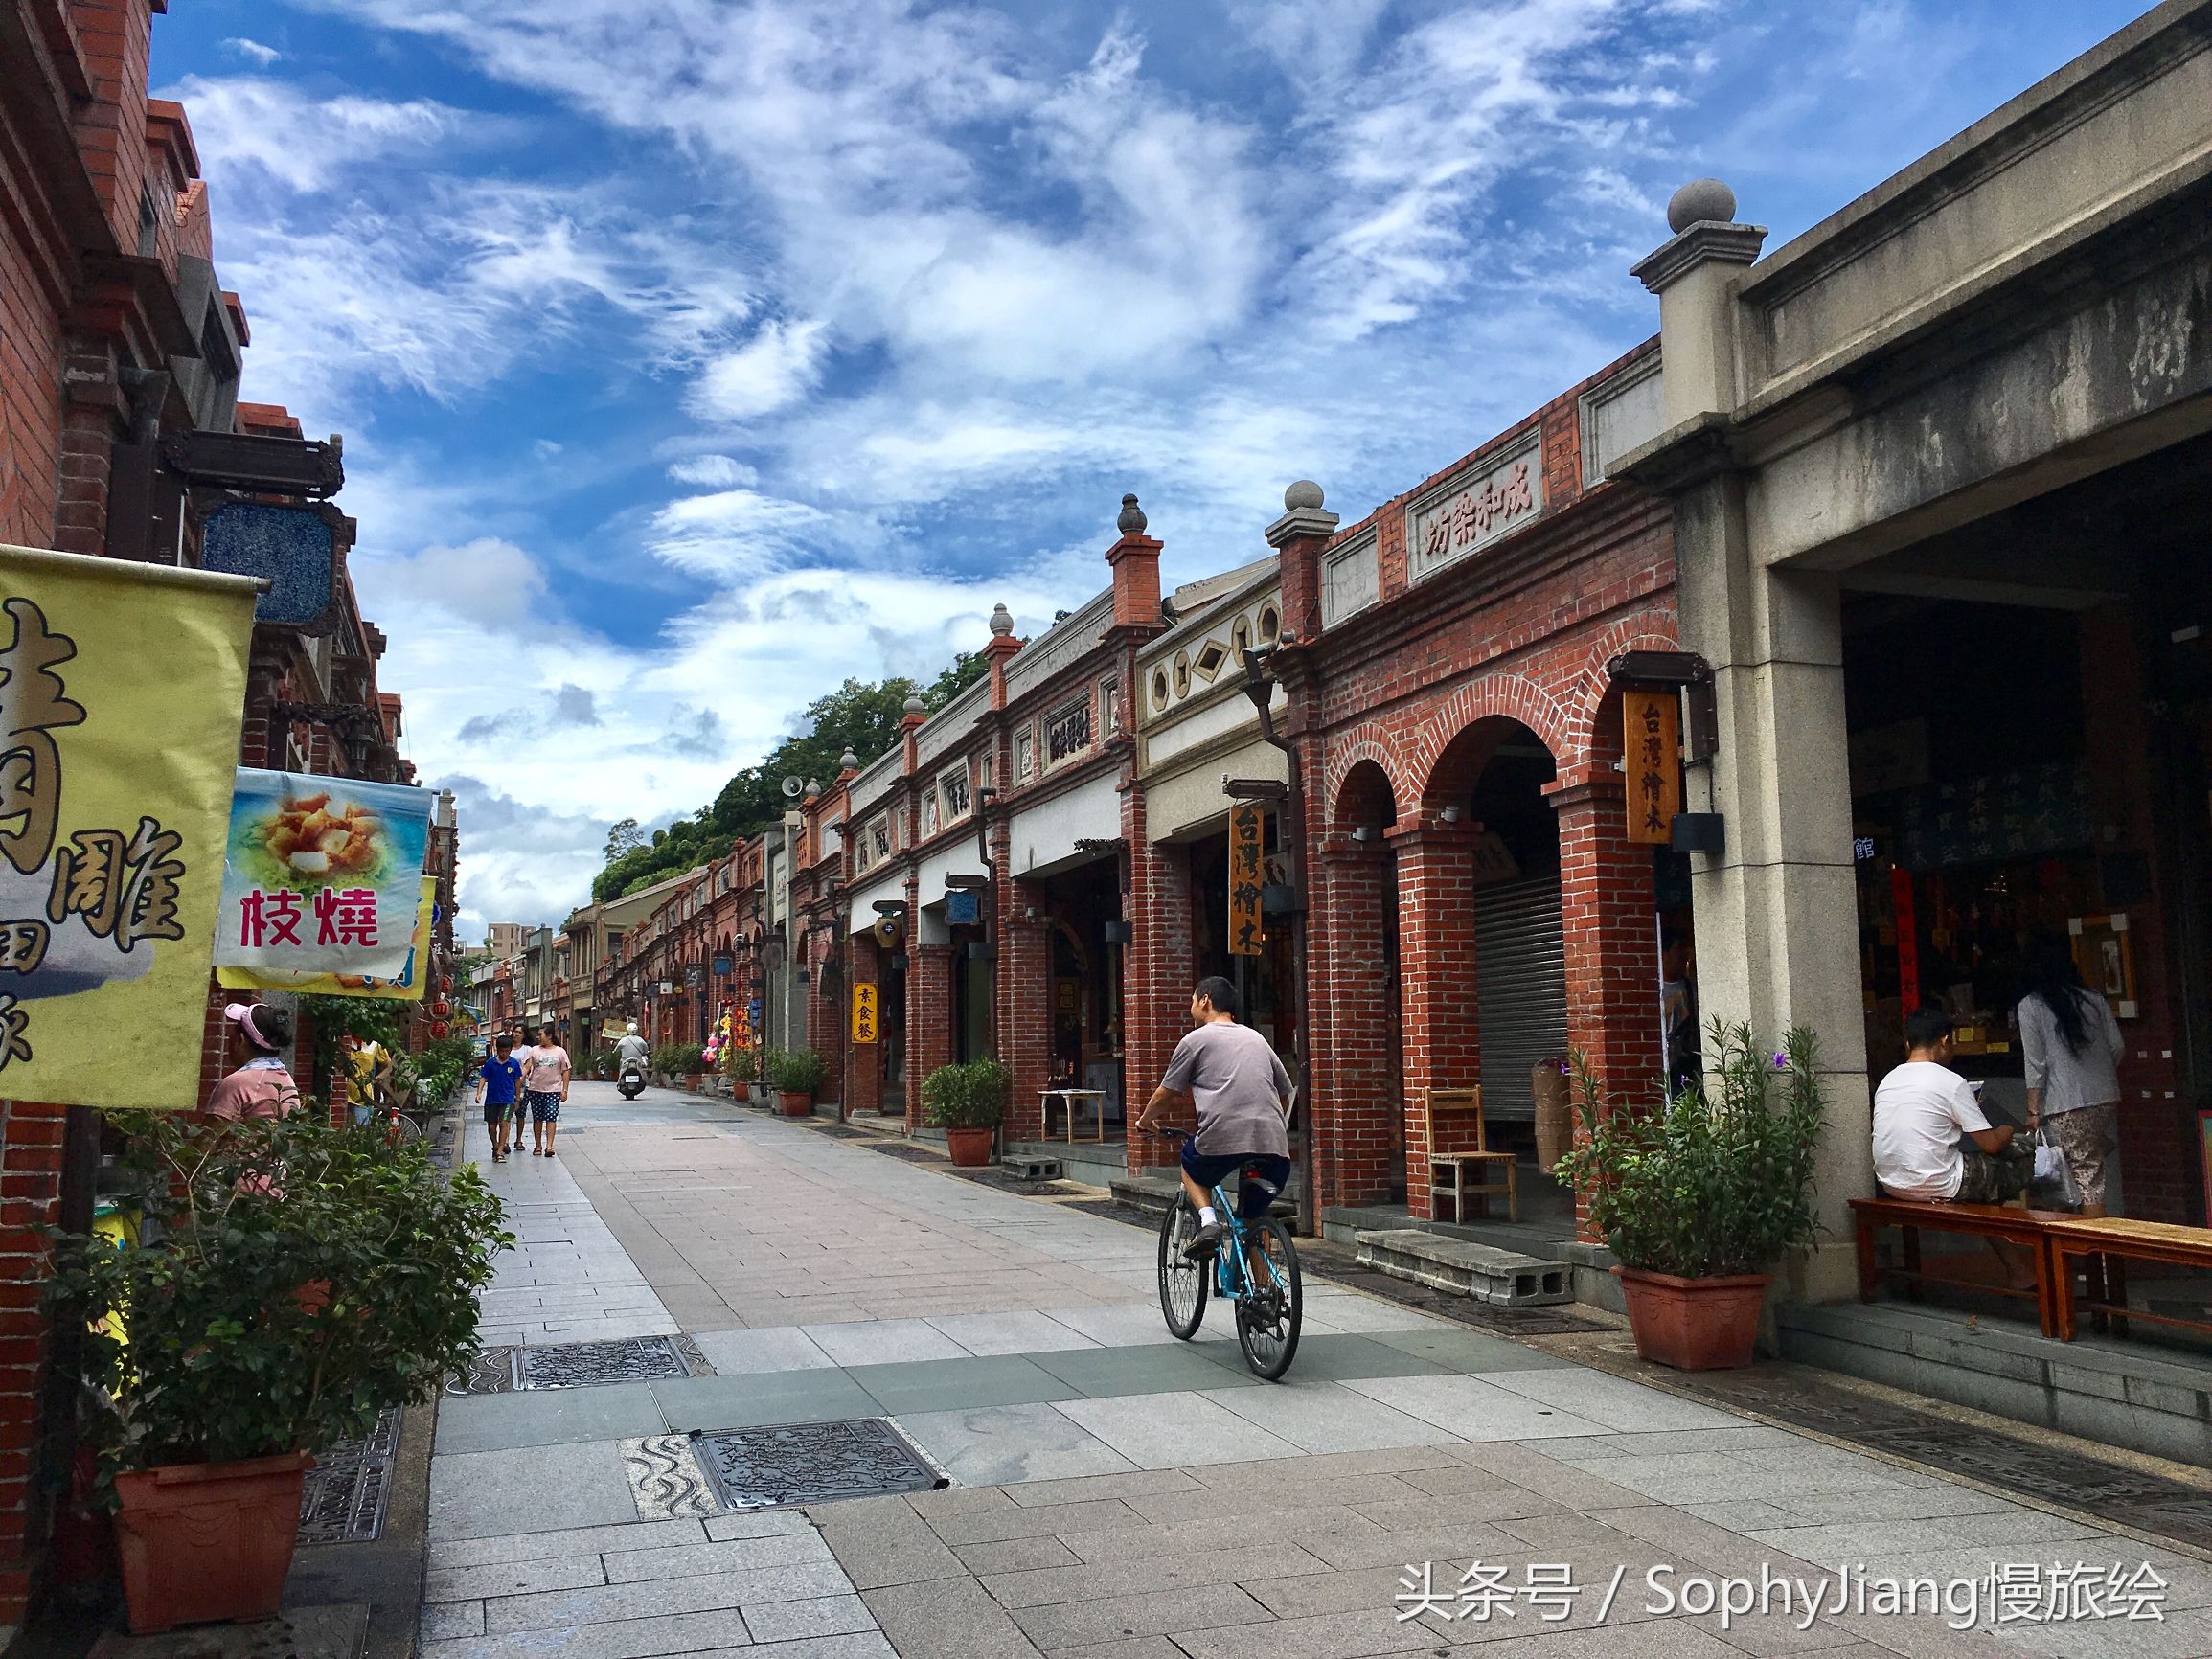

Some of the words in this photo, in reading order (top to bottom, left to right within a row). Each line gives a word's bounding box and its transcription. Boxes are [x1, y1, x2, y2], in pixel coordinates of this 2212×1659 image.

[1641, 703, 1666, 834] 台灣檜木
[240, 888, 378, 947] 枝燒
[1233, 807, 1263, 953] 台灣檜木
[856, 987, 874, 1039] 素食餐
